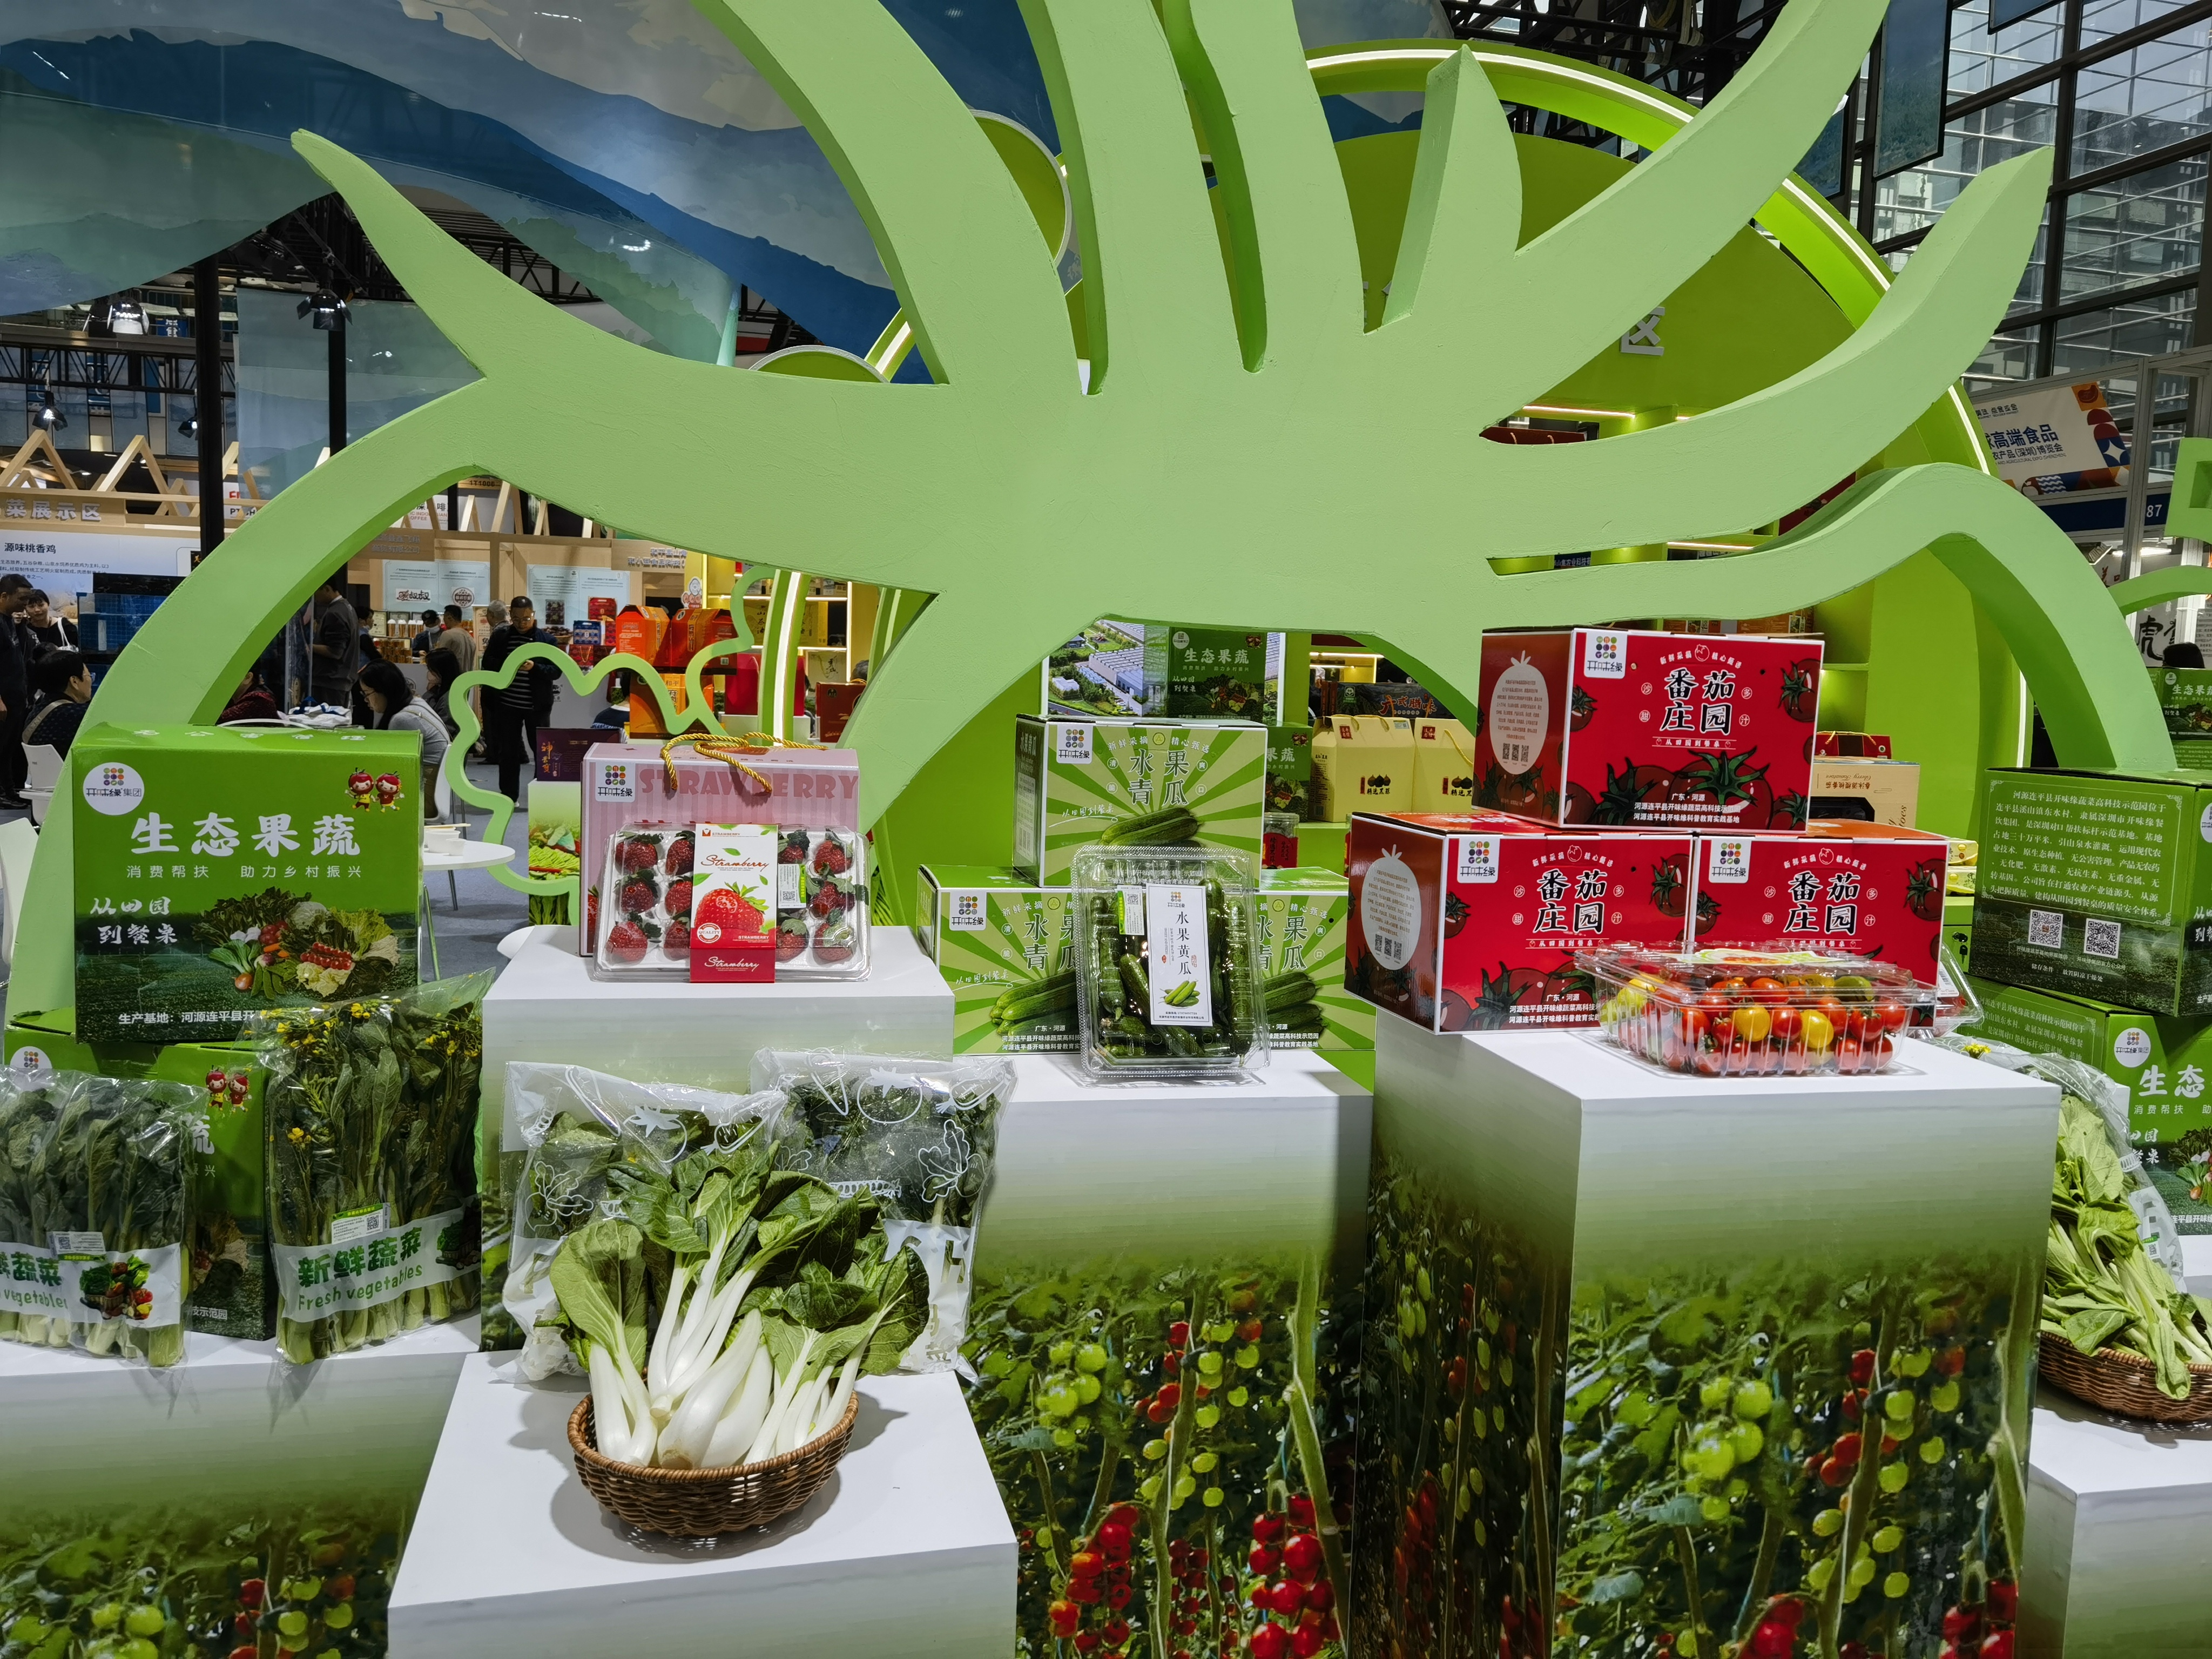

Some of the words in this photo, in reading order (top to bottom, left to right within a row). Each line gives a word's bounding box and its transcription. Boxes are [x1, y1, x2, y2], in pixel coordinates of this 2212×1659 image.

[2146, 504, 2162, 517] 87
[4, 542, 56, 554] 源味桃香鸡
[1184, 648, 1249, 664] 生态果蔬
[1664, 667, 1736, 701] 番茄
[1659, 701, 1732, 736] 庄园
[1107, 736, 1148, 751] 新鲜采摘
[1171, 737, 1210, 753] 精心甄选
[1665, 739, 1719, 747] 从田园到餐桌
[1128, 749, 1190, 777] 水果
[1267, 747, 1295, 762] 果蔬
[639, 768, 858, 799] STRAWBERRY
[1128, 778, 1189, 806] 青瓜
[1062, 804, 1114, 817] 从田园到餐桌
[2013, 790, 2166, 813] 河源连平县开味缘蔬菜高科技示范园位于
[1634, 813, 1739, 824] 河源连平县开味缘科普教育实践基地
[131, 812, 361, 857] 生态果蔬
[701, 854, 769, 872] Strawberry
[1532, 852, 1564, 867] 新鲜采摘
[126, 865, 210, 878] 消费帮扶
[240, 865, 361, 878] 助力乡村振兴
[1537, 868, 1608, 902] 番茄
[1788, 871, 1861, 902] 番茄
[90, 896, 172, 916] 从田园
[1002, 901, 1043, 916] 新鲜采摘
[1290, 903, 1328, 919] 精心甄选
[1022, 913, 1075, 941] 水果
[1257, 915, 1307, 942] 水果
[1533, 902, 1605, 934] 庄园
[1783, 903, 1857, 935] 庄园
[98, 923, 178, 945] 到餐桌
[1176, 911, 1191, 975] 水果黄瓜
[1539, 940, 1594, 948] 从田园到餐桌
[704, 956, 759, 972] Strawberry
[1022, 943, 1076, 970] 青瓜
[1259, 944, 1307, 970] 青瓜
[955, 970, 1009, 985] 从田园到餐桌
[1546, 994, 1580, 1002] 广东·河源
[2139, 1064, 2205, 1098] 生态
[2134, 1104, 2184, 1115] 消费帮扶
[298, 1226, 422, 1289] 新鲜蔬菜
[298, 1285, 342, 1311] Fresh
[347, 1264, 423, 1300] vegetables
